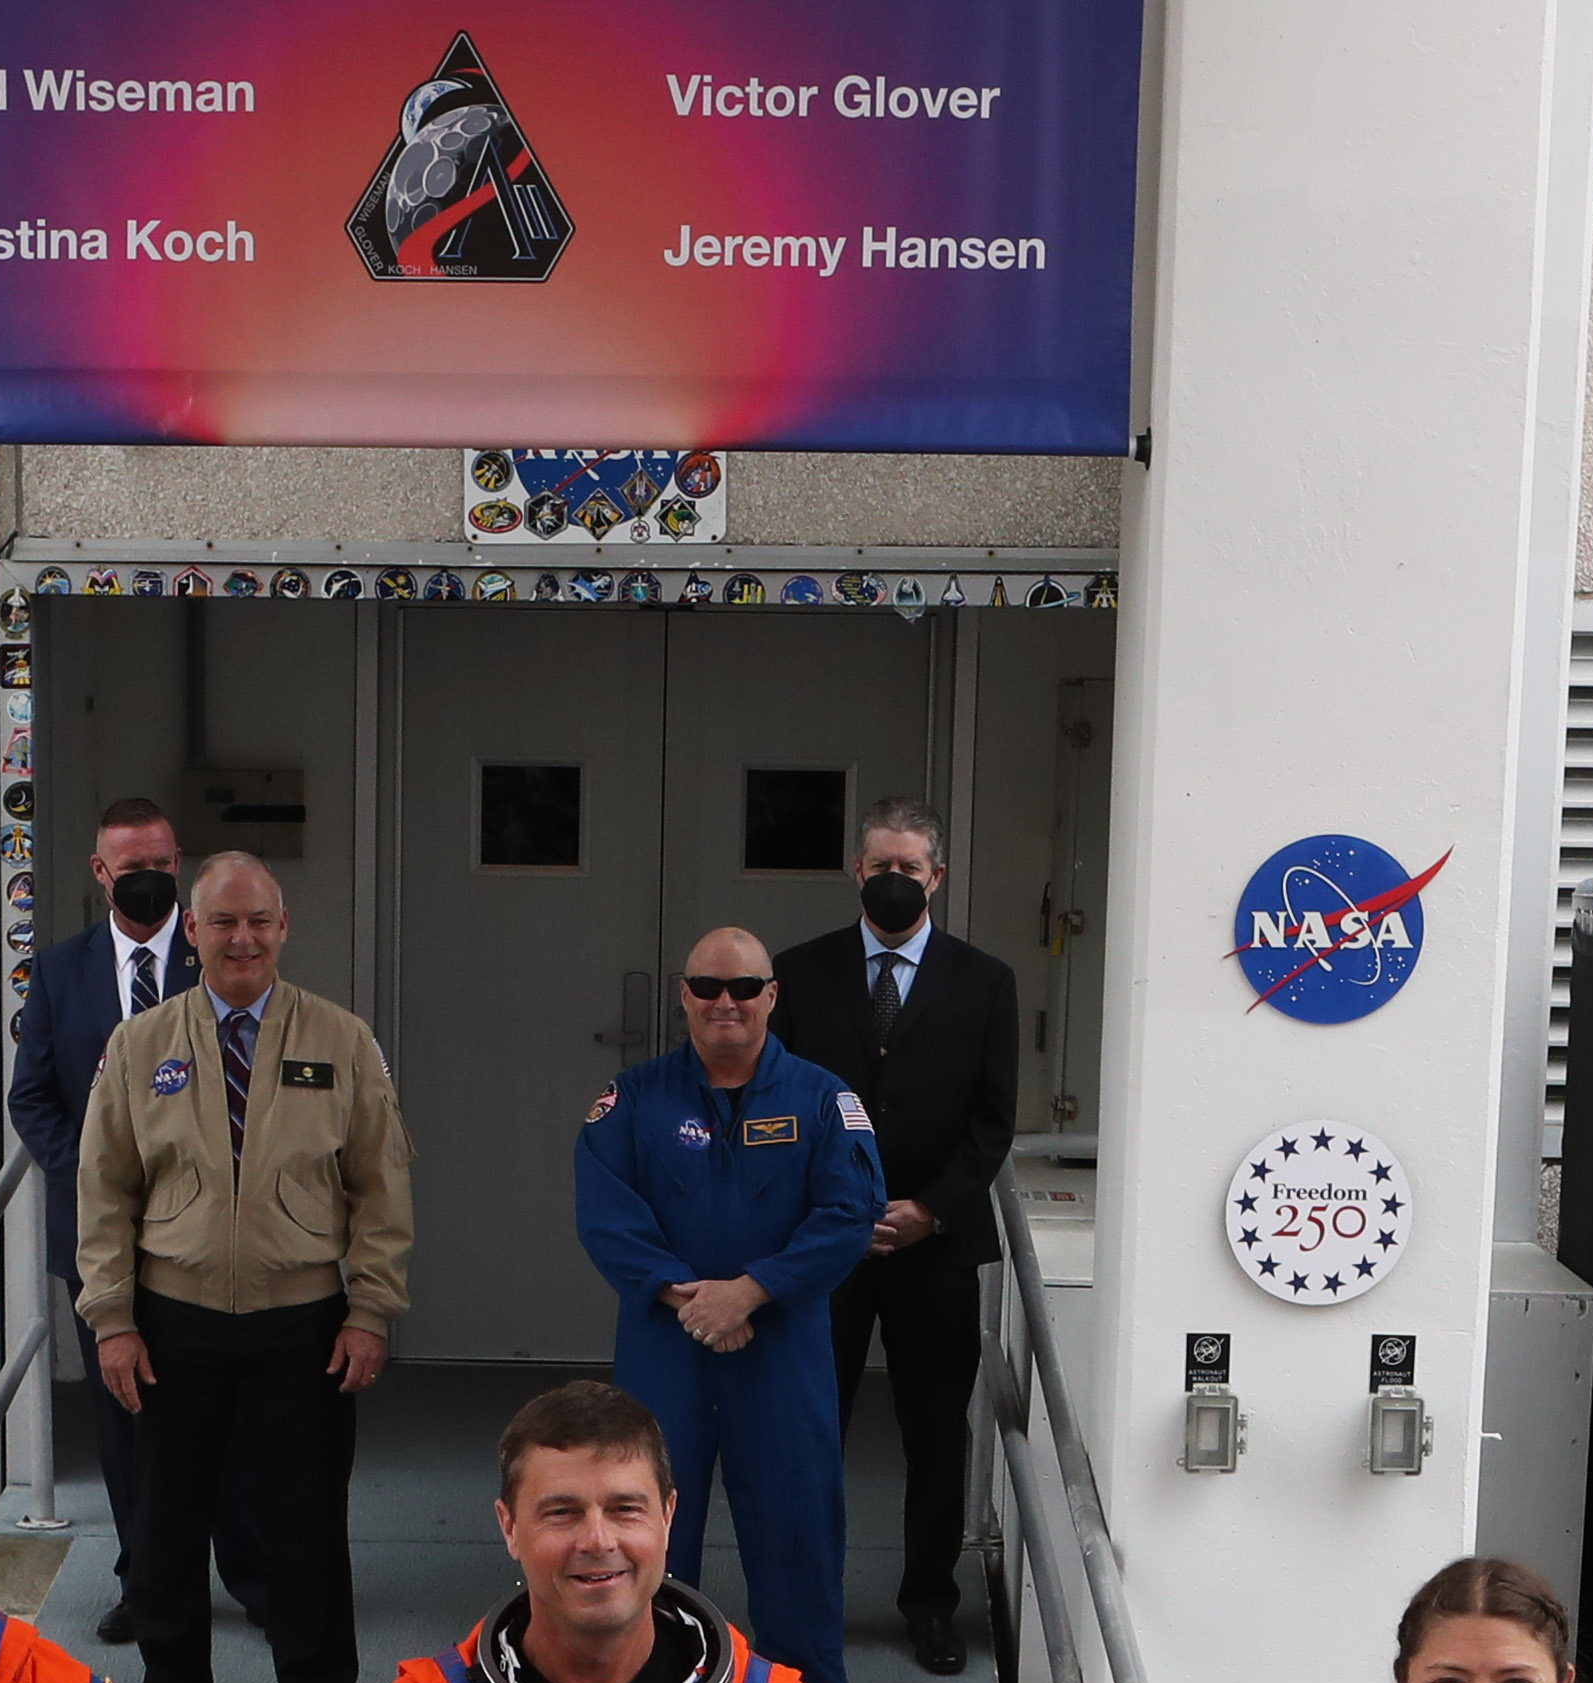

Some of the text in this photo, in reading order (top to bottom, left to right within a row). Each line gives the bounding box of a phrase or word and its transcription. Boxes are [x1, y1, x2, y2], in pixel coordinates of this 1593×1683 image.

[23, 68, 256, 113] Wiseman
[665, 74, 1001, 119] Victor Glover
[357, 171, 391, 223] WISEMAN
[126, 219, 255, 262] Koch
[354, 225, 384, 272] GLOVER
[663, 224, 1047, 277] Jeremy Hansen
[387, 264, 478, 276] KOCH HANSEN
[1249, 910, 1414, 950] NASA
[155, 1069, 187, 1085] NASA
[679, 1125, 712, 1141] NASA
[1271, 1182, 1369, 1203] Freedom
[1270, 1203, 1368, 1252] 250
